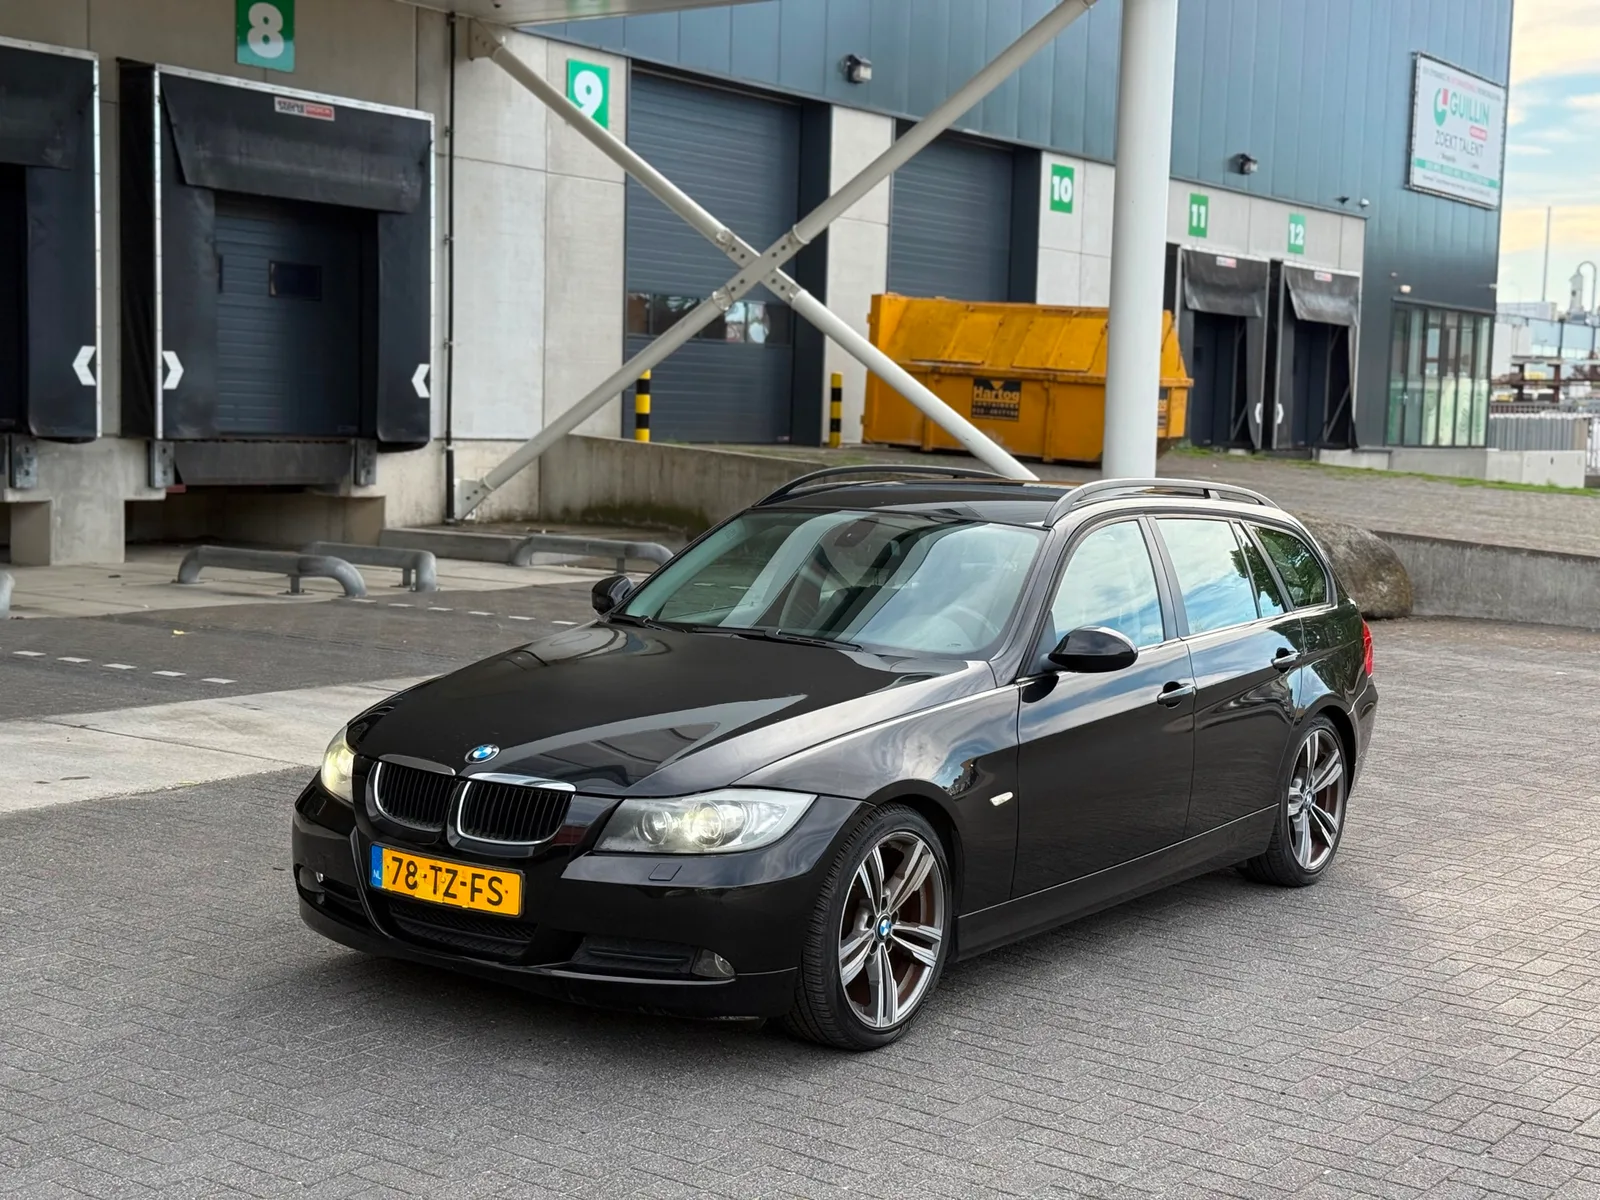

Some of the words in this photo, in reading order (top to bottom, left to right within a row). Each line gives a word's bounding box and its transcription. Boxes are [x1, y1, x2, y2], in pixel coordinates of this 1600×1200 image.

[247, 2, 284, 58] 8
[574, 70, 603, 118] 9
[1450, 92, 1490, 127] GUILLIN
[1435, 130, 1459, 150] ZOEKT
[1459, 136, 1484, 157] TALENT
[1053, 175, 1072, 203] 10
[1191, 204, 1206, 228] 11
[1290, 223, 1304, 246] 12
[973, 386, 1020, 403] Hartog
[373, 869, 381, 880] NL
[391, 856, 503, 906] 78-TZ-FS
